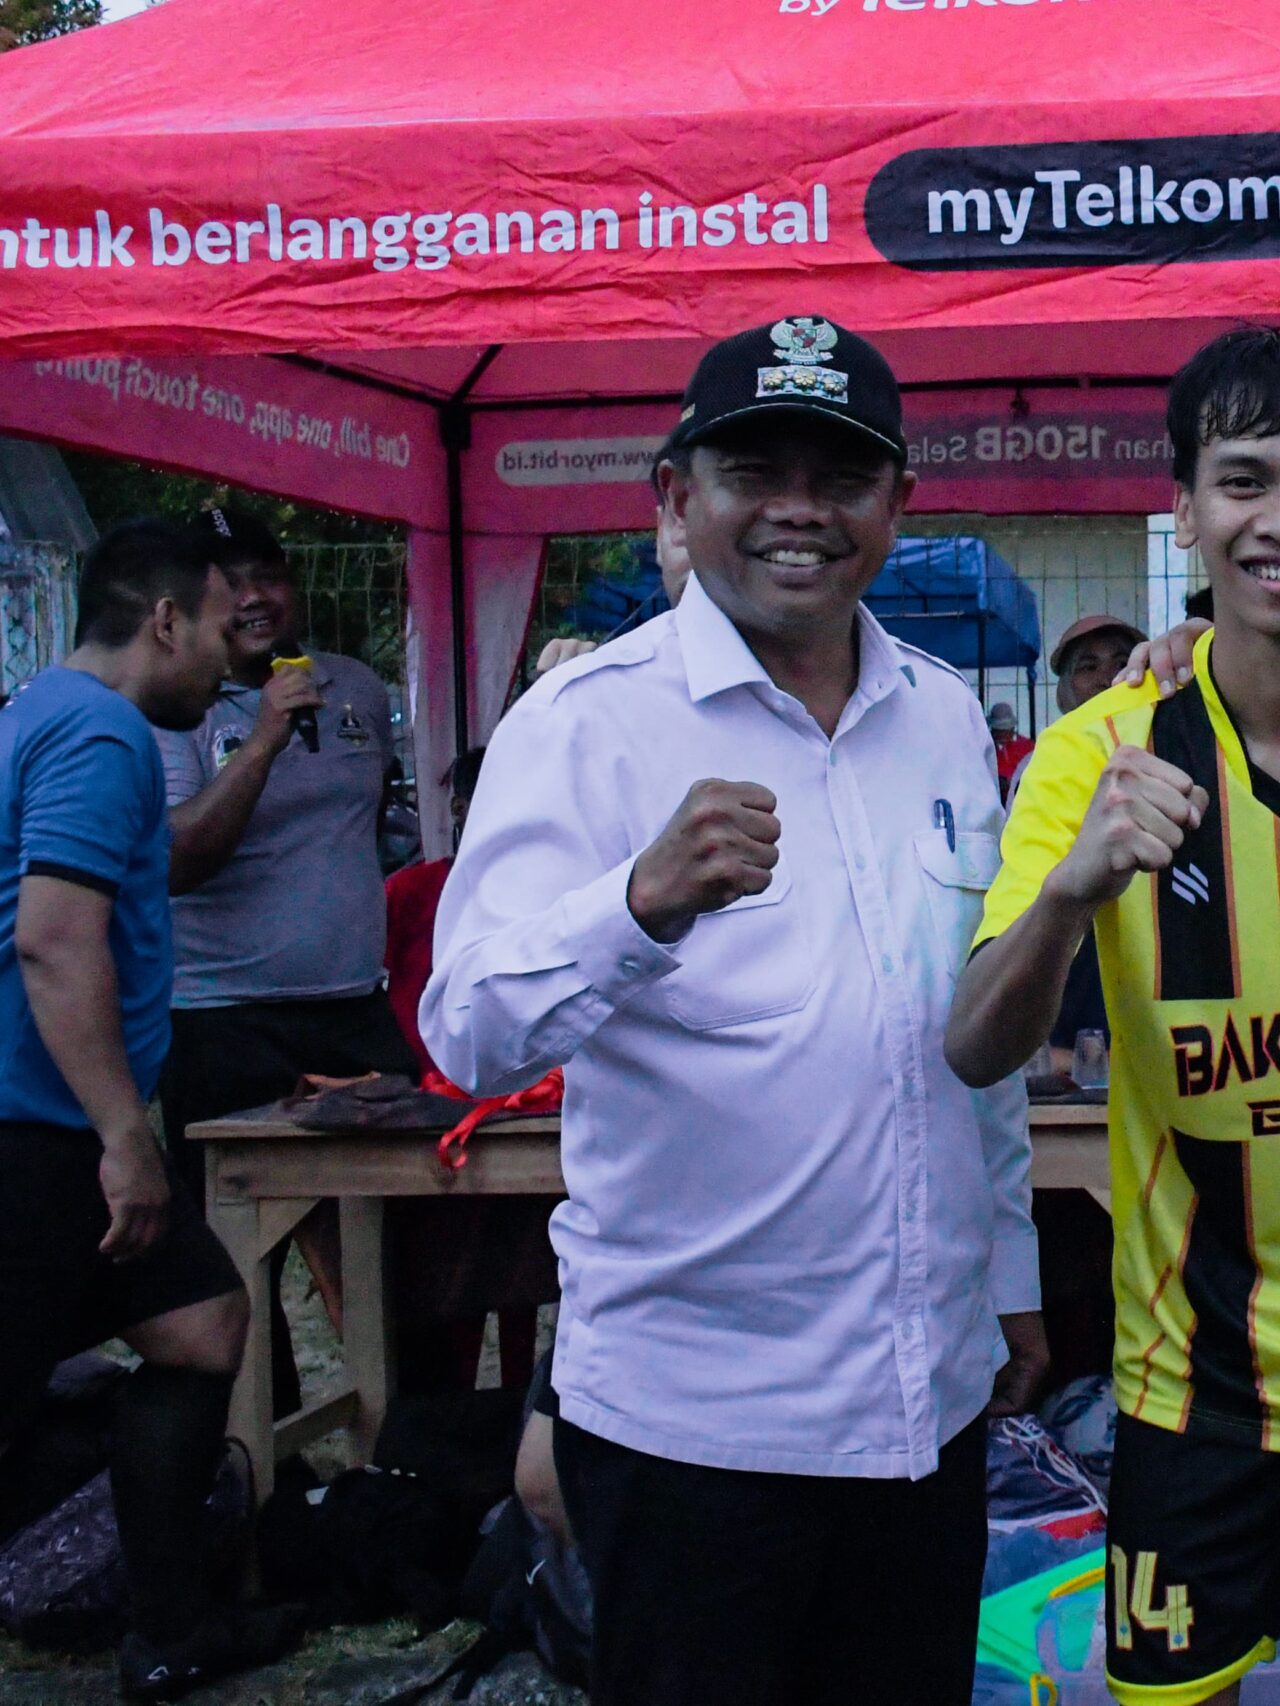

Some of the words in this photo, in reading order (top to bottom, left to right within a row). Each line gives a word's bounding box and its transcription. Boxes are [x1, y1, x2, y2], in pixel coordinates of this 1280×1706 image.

[148, 203, 620, 271] berlangganan
[638, 183, 829, 250] instal
[1111, 1543, 1195, 1653] 14
